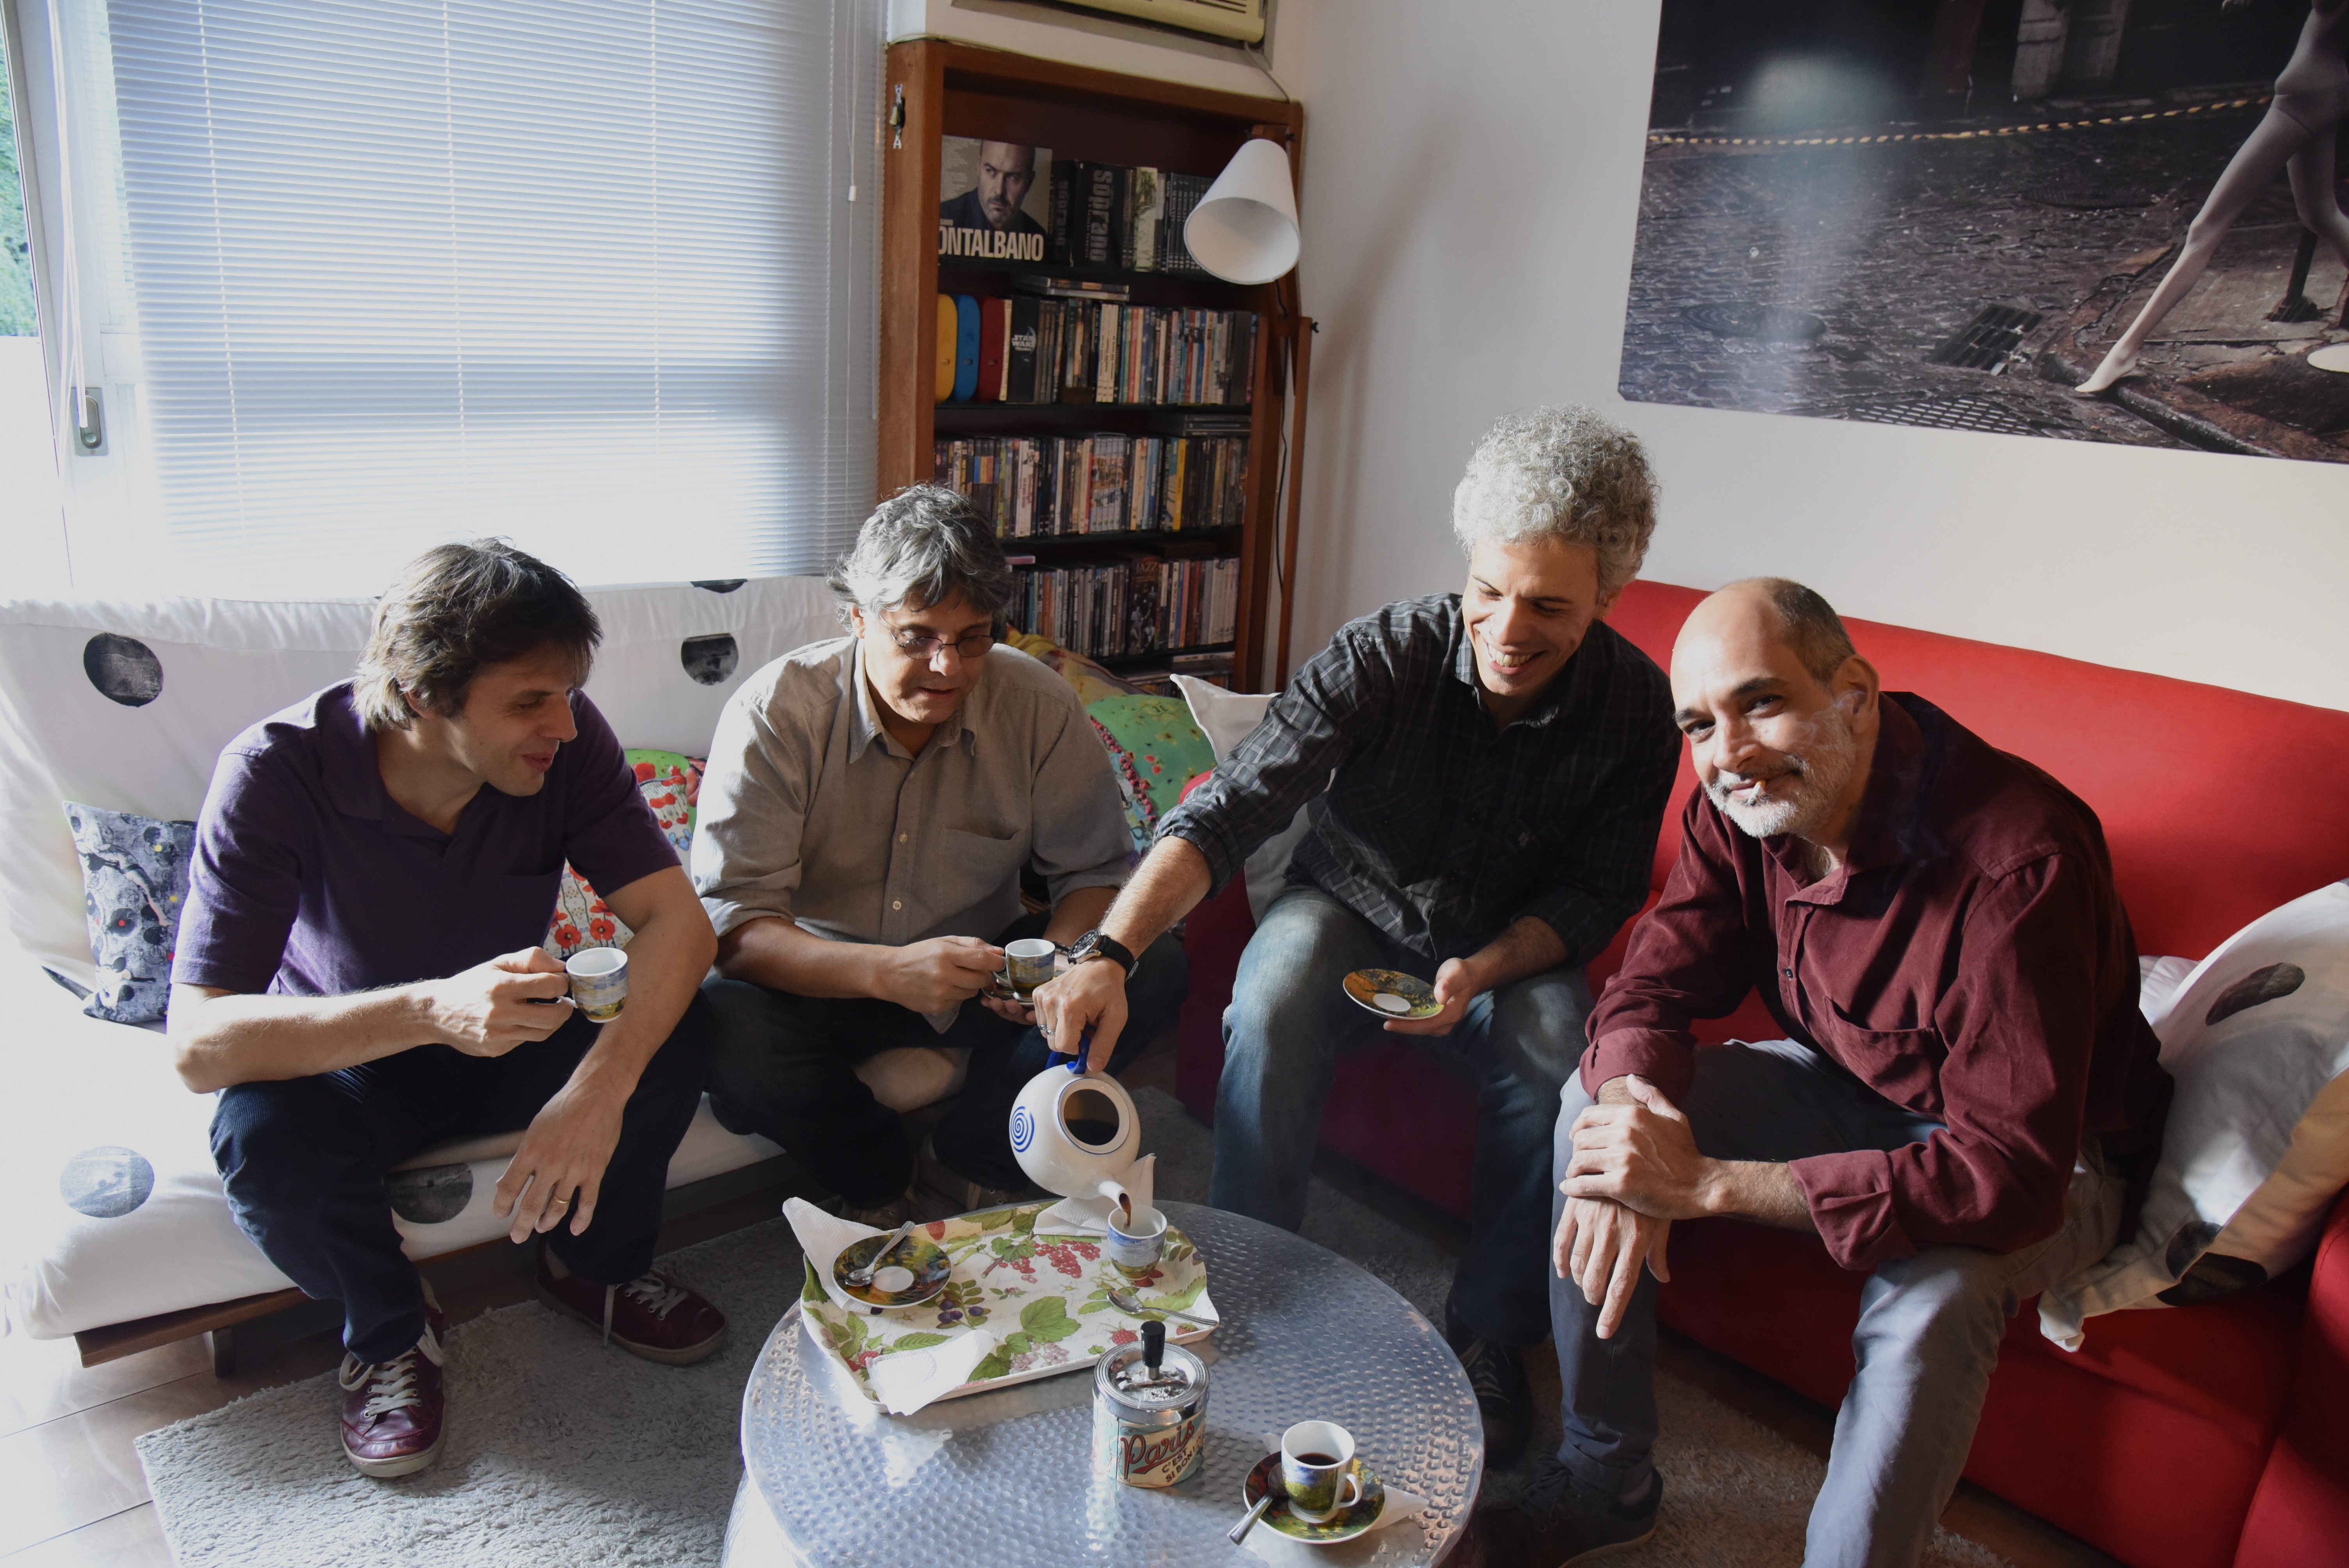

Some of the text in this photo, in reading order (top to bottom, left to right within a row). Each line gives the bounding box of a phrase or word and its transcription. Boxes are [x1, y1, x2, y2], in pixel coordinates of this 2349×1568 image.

[1136, 562, 1158, 573] JAZZ
[1120, 1420, 1194, 1480] Paris
[1162, 1447, 1187, 1473] C'EST
[1166, 1470, 1176, 1482] SI
